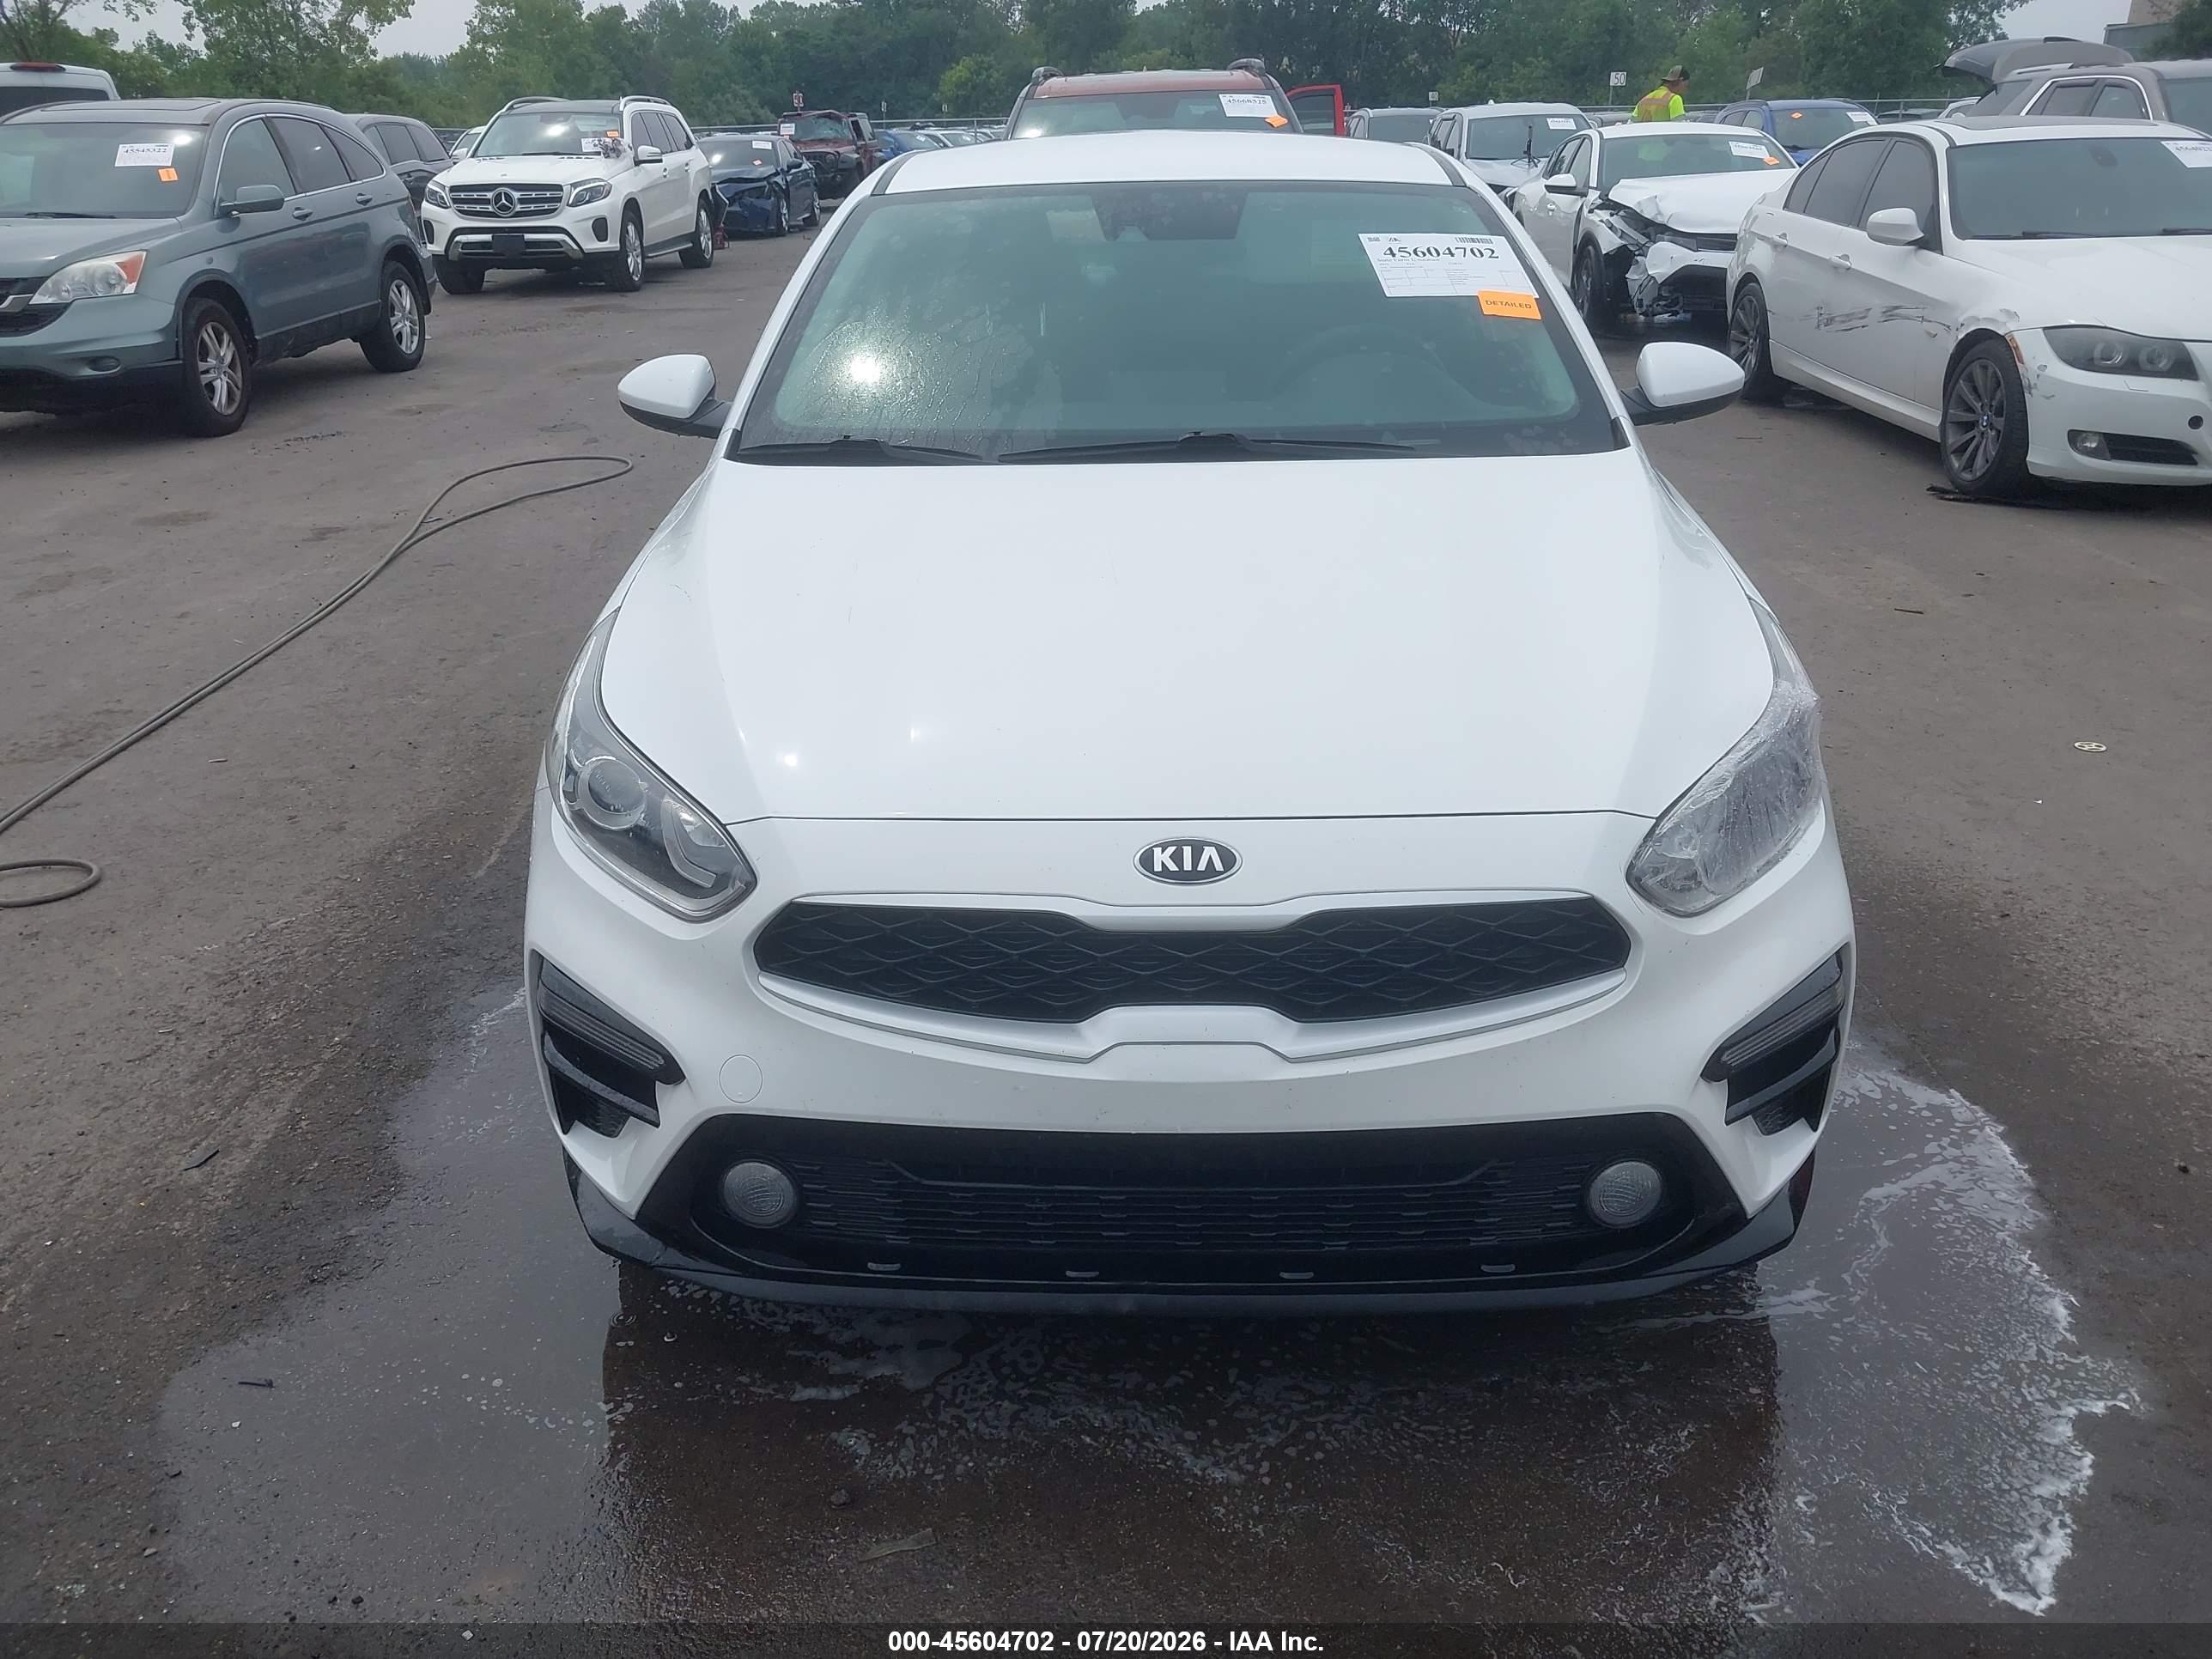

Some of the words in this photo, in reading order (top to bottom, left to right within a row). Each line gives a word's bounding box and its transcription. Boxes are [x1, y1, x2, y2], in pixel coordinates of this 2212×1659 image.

[1613, 72, 1626, 85] 50
[1383, 246, 1500, 259] 45604702
[1484, 298, 1532, 310] DETAILED
[1152, 844, 1224, 872] KIA
